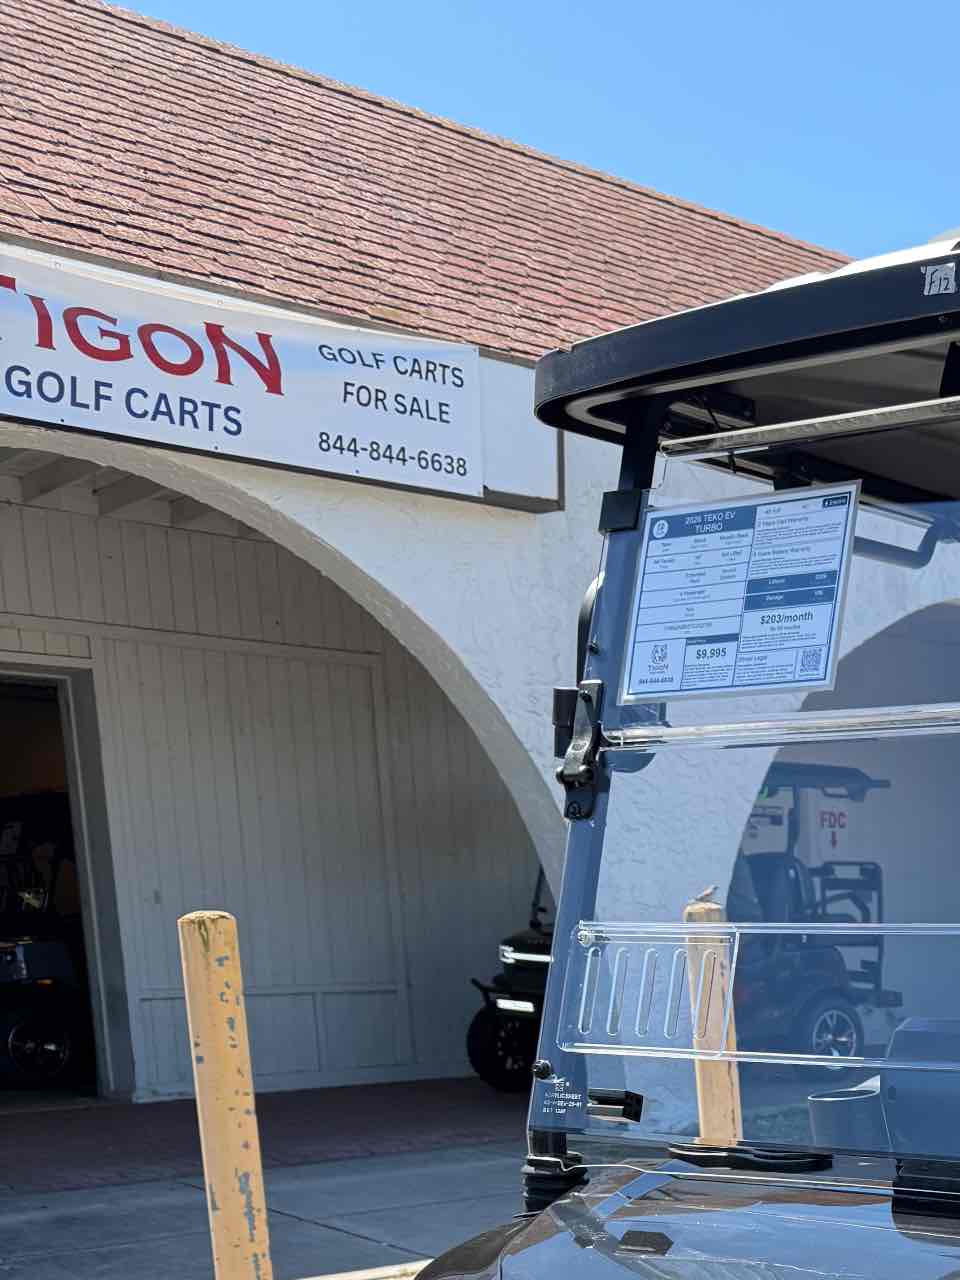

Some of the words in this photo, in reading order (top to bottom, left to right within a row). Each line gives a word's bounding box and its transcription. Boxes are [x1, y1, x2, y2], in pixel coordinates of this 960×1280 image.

[0, 274, 285, 396] IGON
[318, 344, 386, 370] GOLF
[393, 355, 464, 388] CARTS
[5, 365, 113, 411] GOLF
[125, 387, 242, 436] CARTS
[343, 381, 388, 412] FOR
[394, 393, 451, 424] SALE
[318, 432, 468, 477] 844-844-6638
[703, 512, 724, 523] TEKO
[819, 810, 847, 829] FDC
